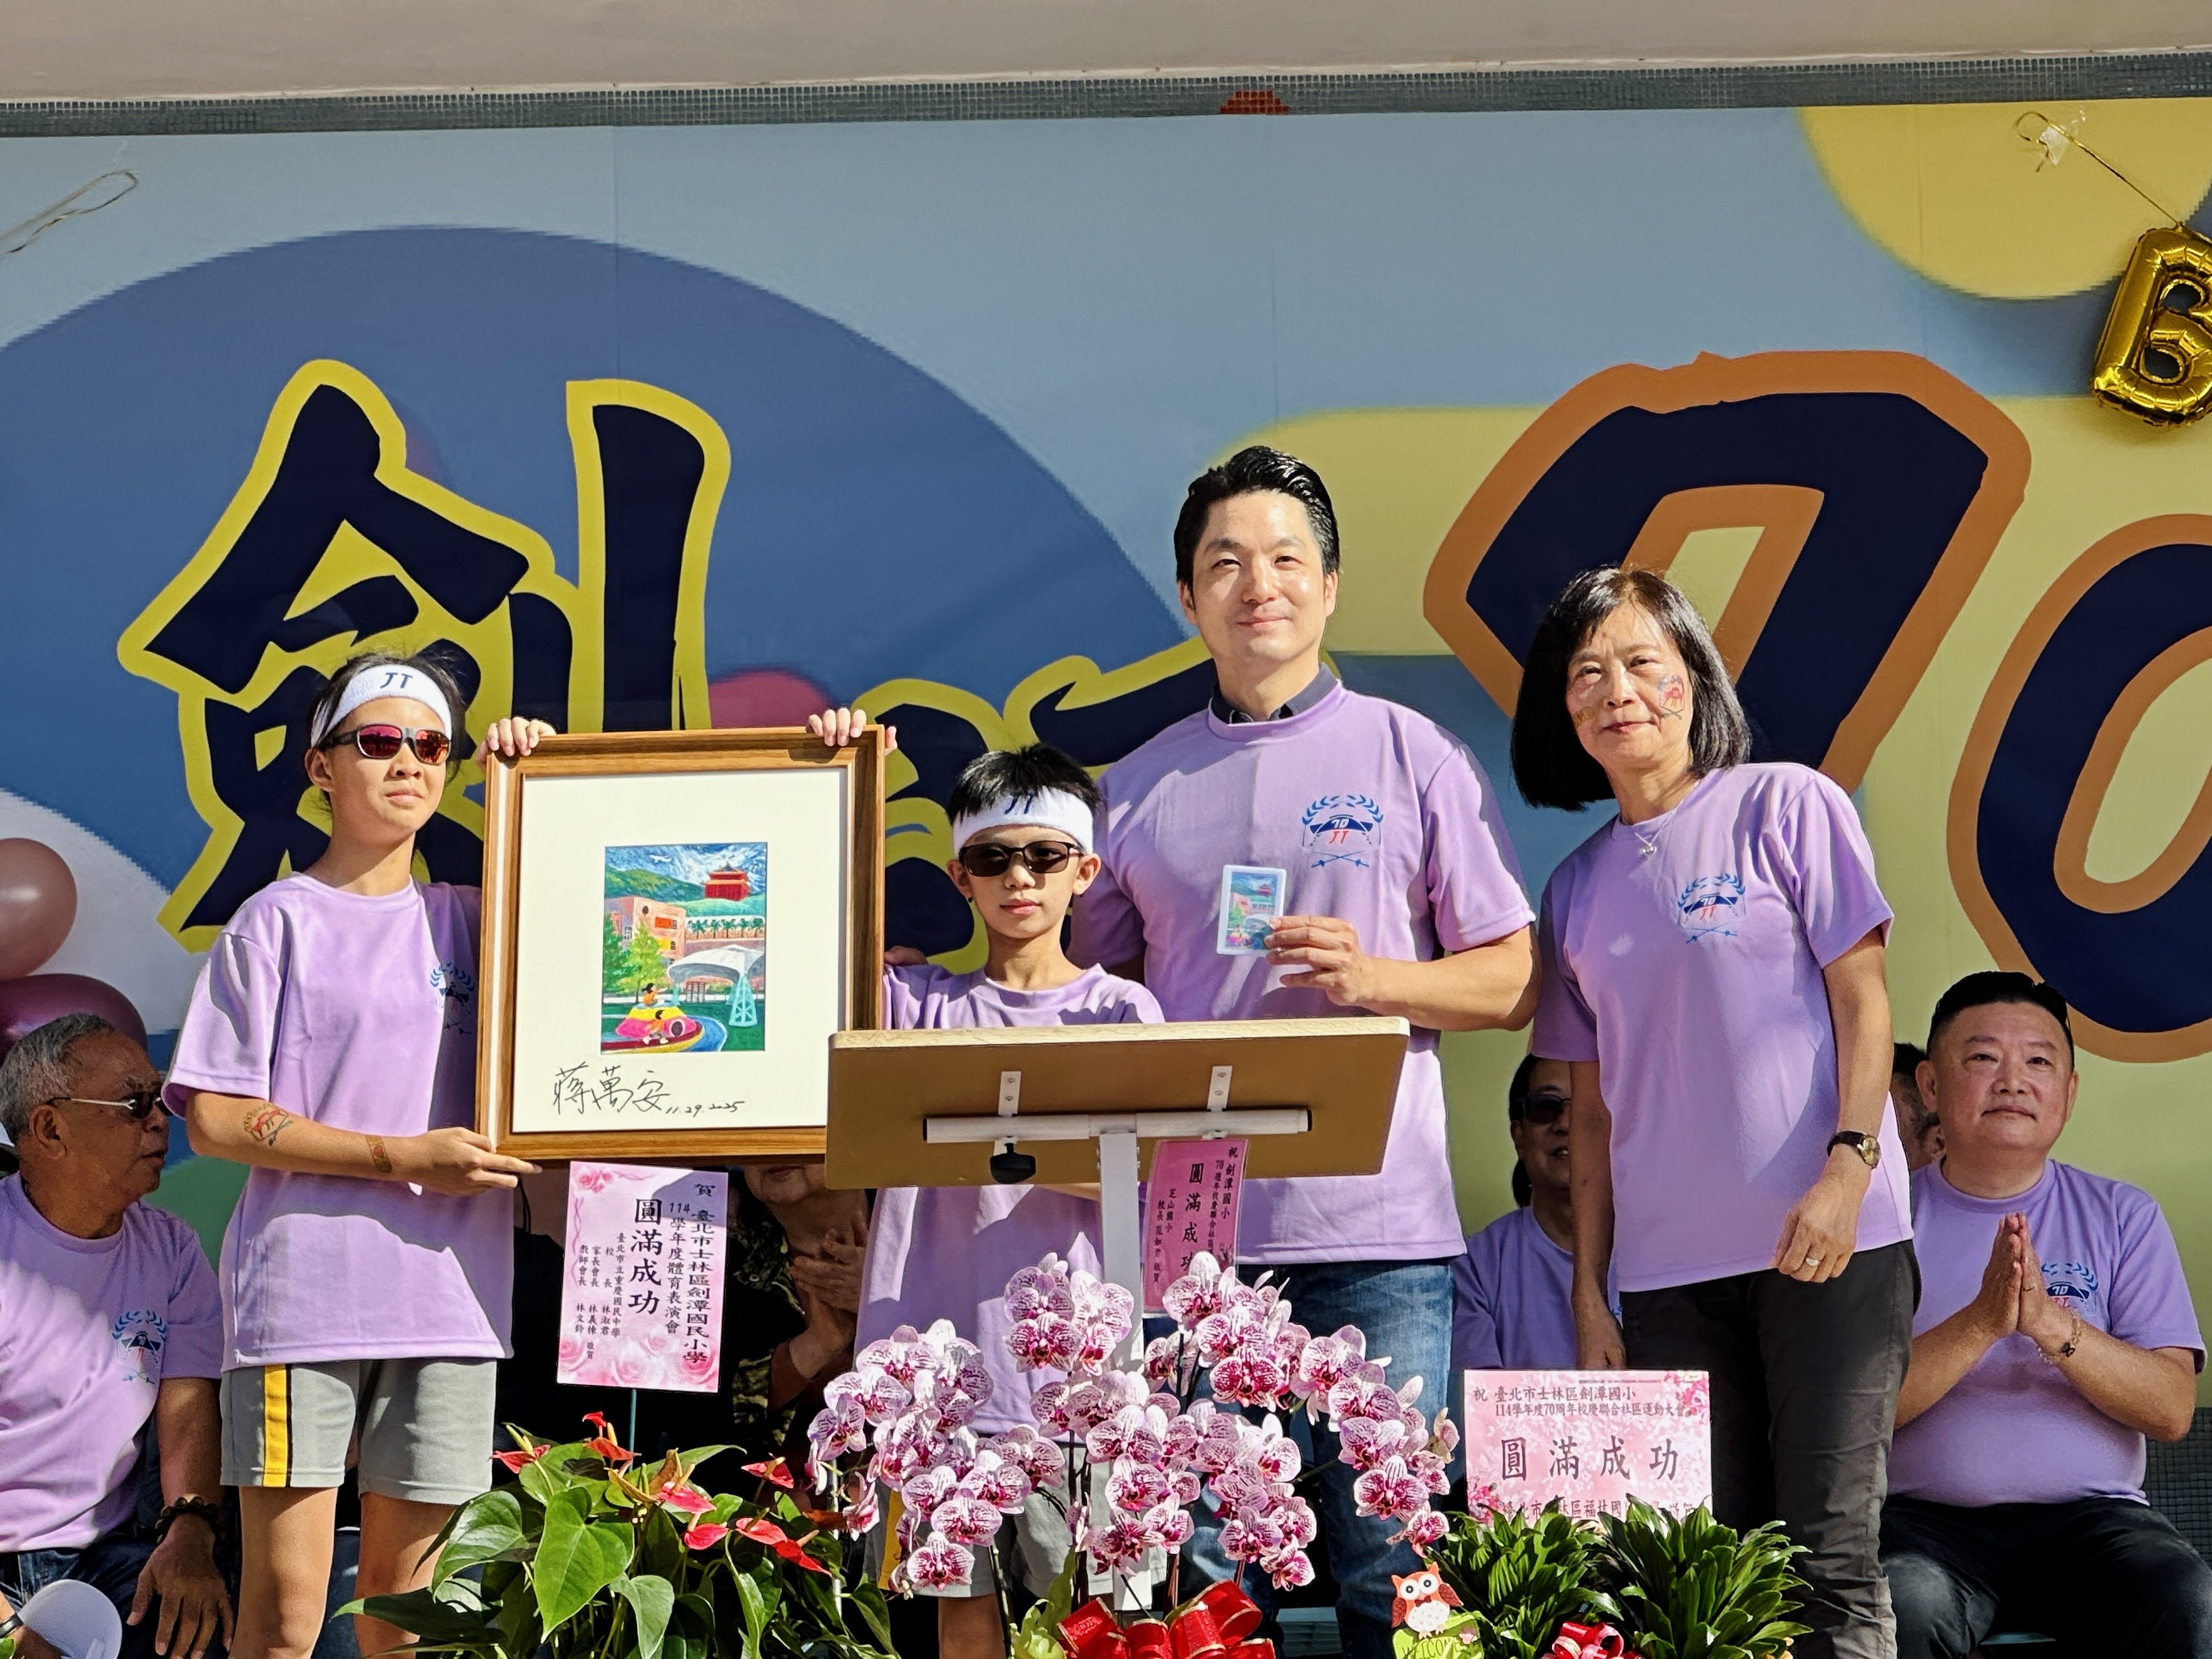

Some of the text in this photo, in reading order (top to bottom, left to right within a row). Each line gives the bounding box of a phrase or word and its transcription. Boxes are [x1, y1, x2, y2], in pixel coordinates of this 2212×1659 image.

[380, 672, 413, 689] JT
[1329, 830, 1349, 845] JT
[1331, 818, 1350, 830] 70
[553, 1061, 671, 1115] 蔣萬安
[578, 1244, 590, 1286] 教師會長
[590, 1245, 602, 1288] 家長會長
[627, 1198, 663, 1315] 圓滿成功
[664, 1201, 691, 1335] 114學年度體育表演會
[682, 1183, 716, 1364] 賀 臺北市士林區劍潭國民小學
[1474, 1385, 1637, 1403] 祝 臺北市士林區劍潭國小
[1501, 1435, 1679, 1481] 圓滿成功
